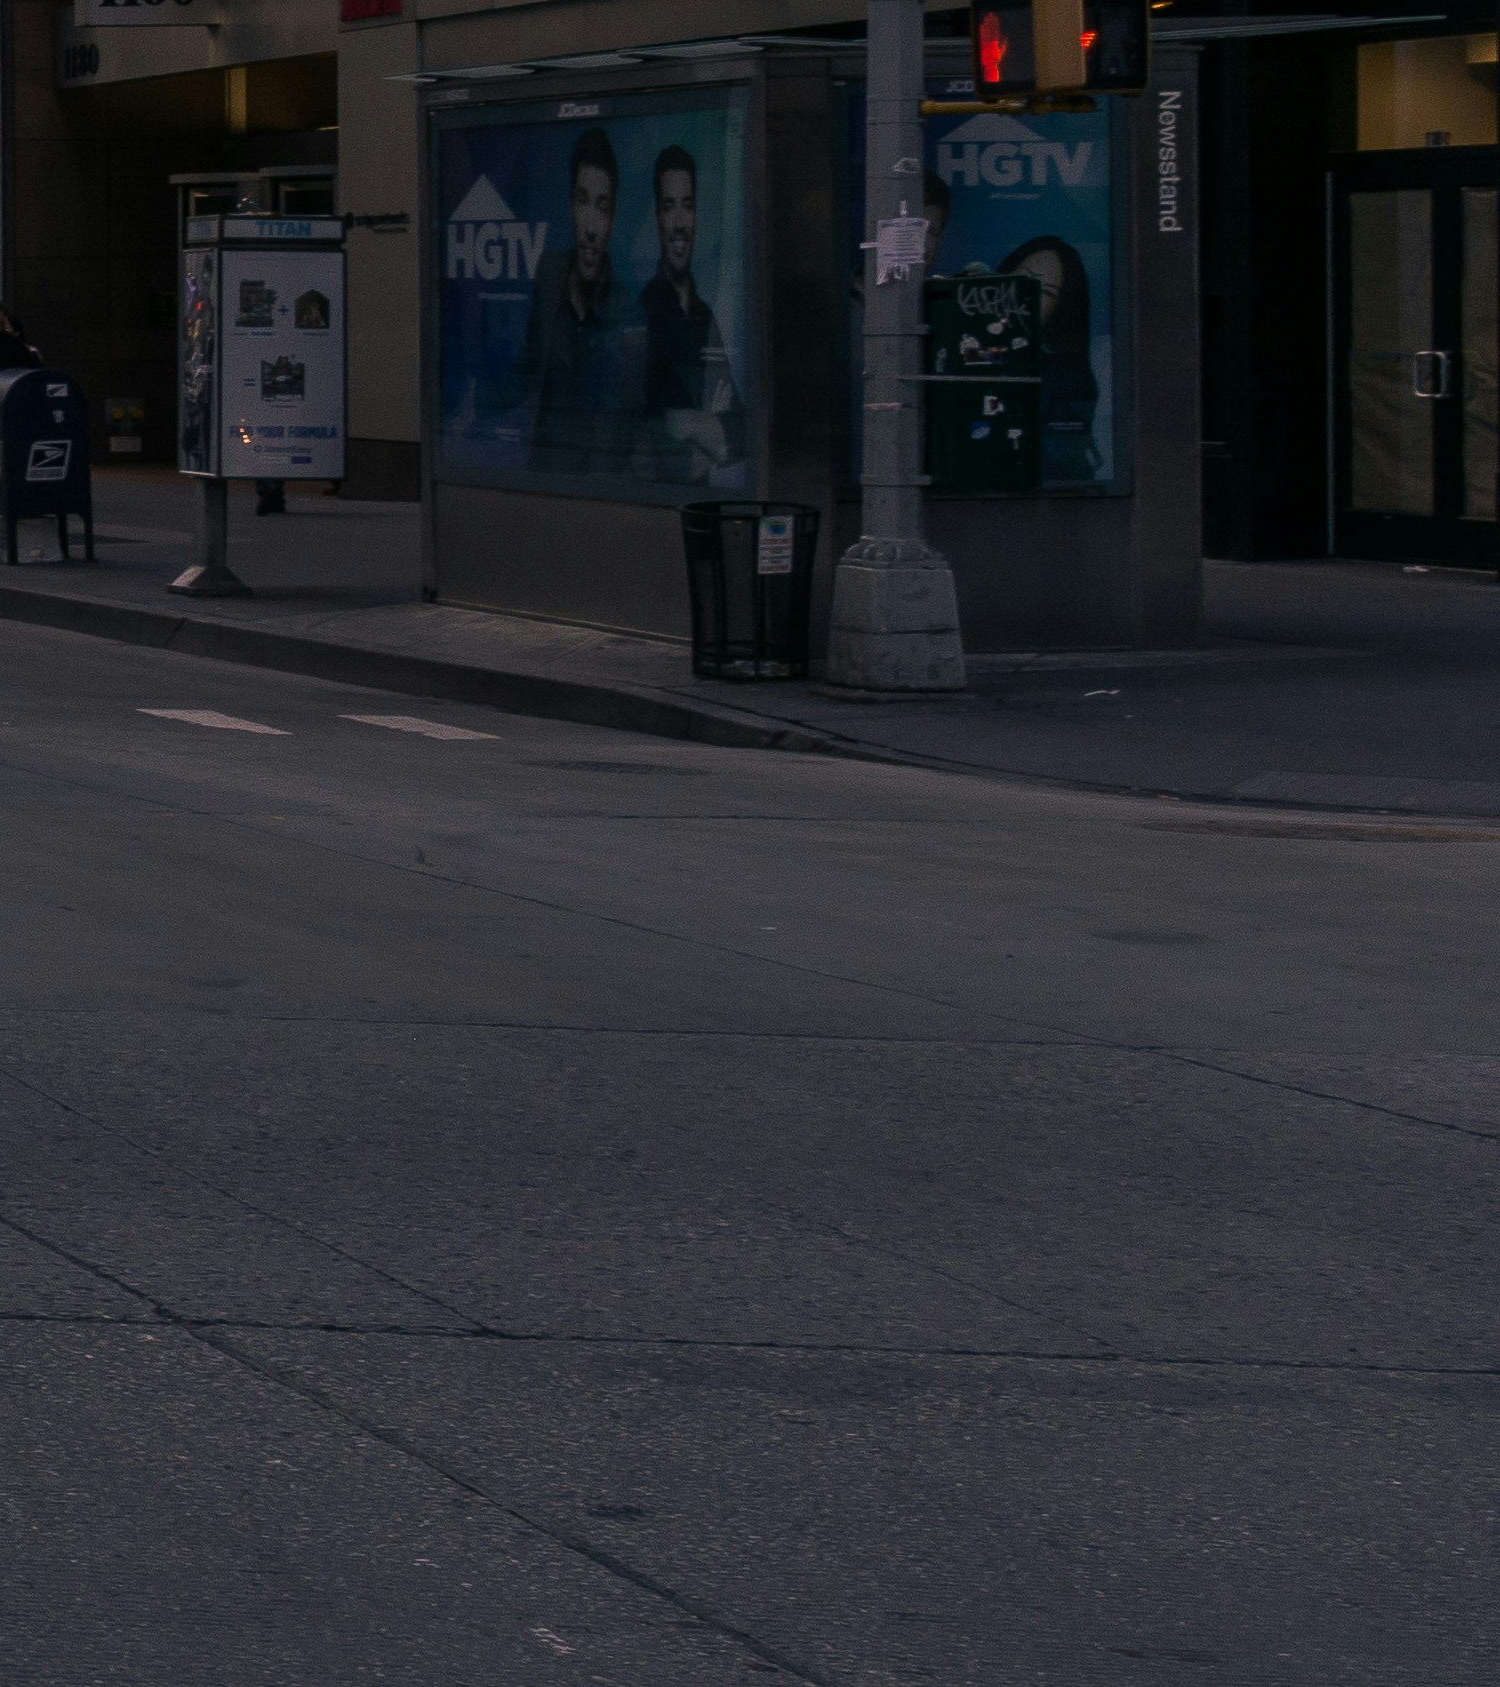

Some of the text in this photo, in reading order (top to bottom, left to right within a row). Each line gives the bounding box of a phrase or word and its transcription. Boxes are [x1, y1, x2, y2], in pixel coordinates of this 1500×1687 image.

[64, 43, 99, 78] 1180
[936, 142, 1094, 187] HGTV
[1158, 90, 1183, 233] Newsstand
[256, 221, 312, 236] TITAN
[447, 221, 548, 281] HGTV
